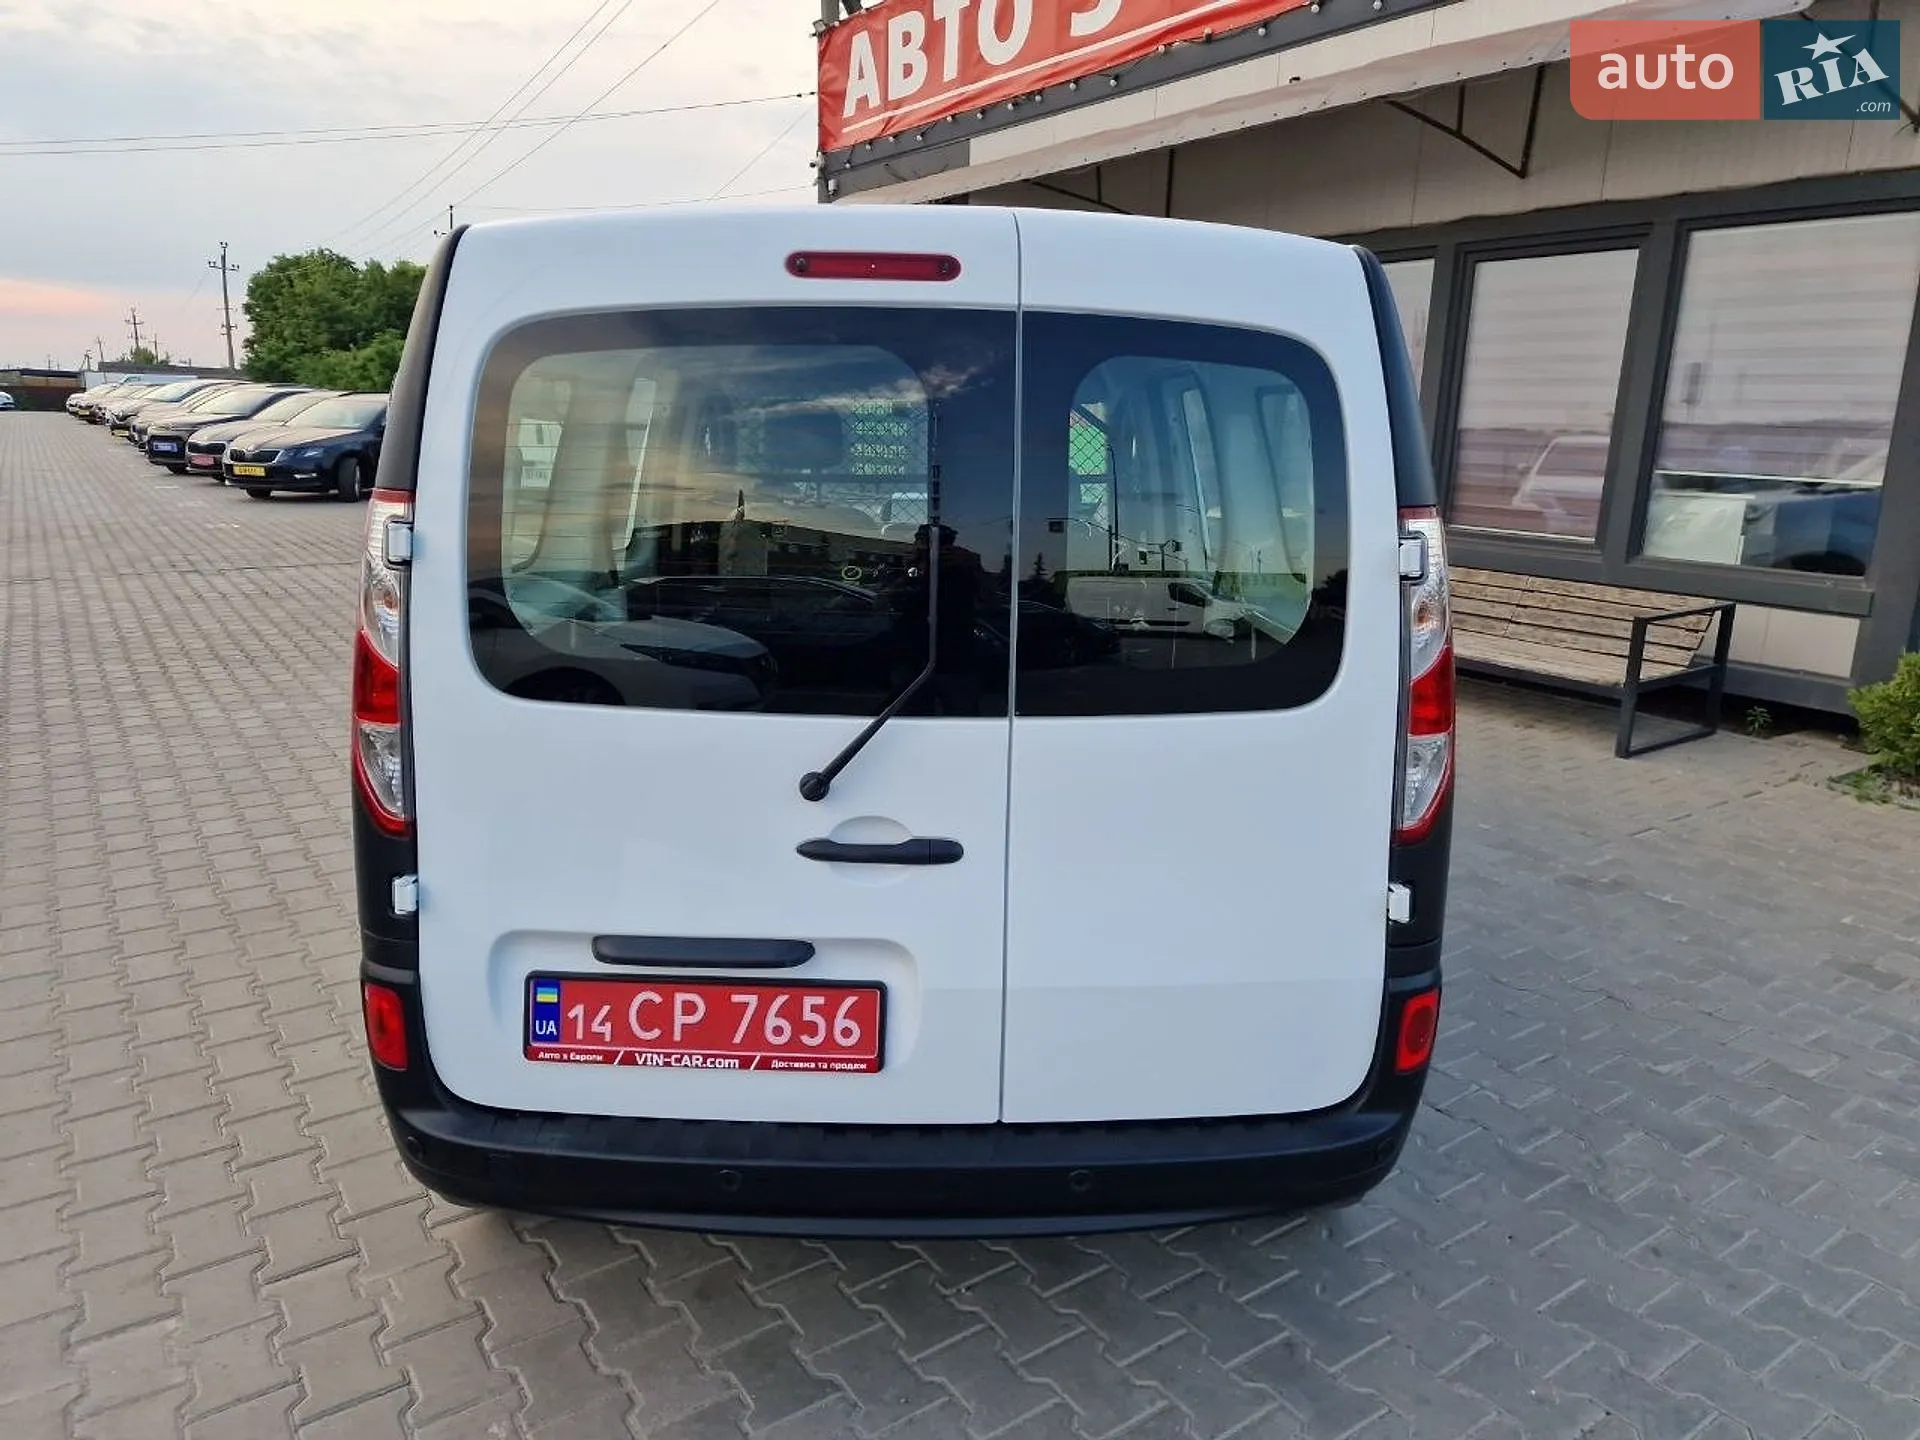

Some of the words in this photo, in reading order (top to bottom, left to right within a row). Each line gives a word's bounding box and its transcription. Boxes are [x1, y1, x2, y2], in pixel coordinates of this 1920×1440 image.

[842, 0, 1033, 119] АВТО
[566, 1003, 613, 1042] 14
[628, 990, 707, 1042] CP
[730, 994, 861, 1047] 7656
[535, 1019, 558, 1036] UA
[635, 1052, 740, 1069] VIN-CAR.com
[770, 1059, 816, 1069] Доставка
